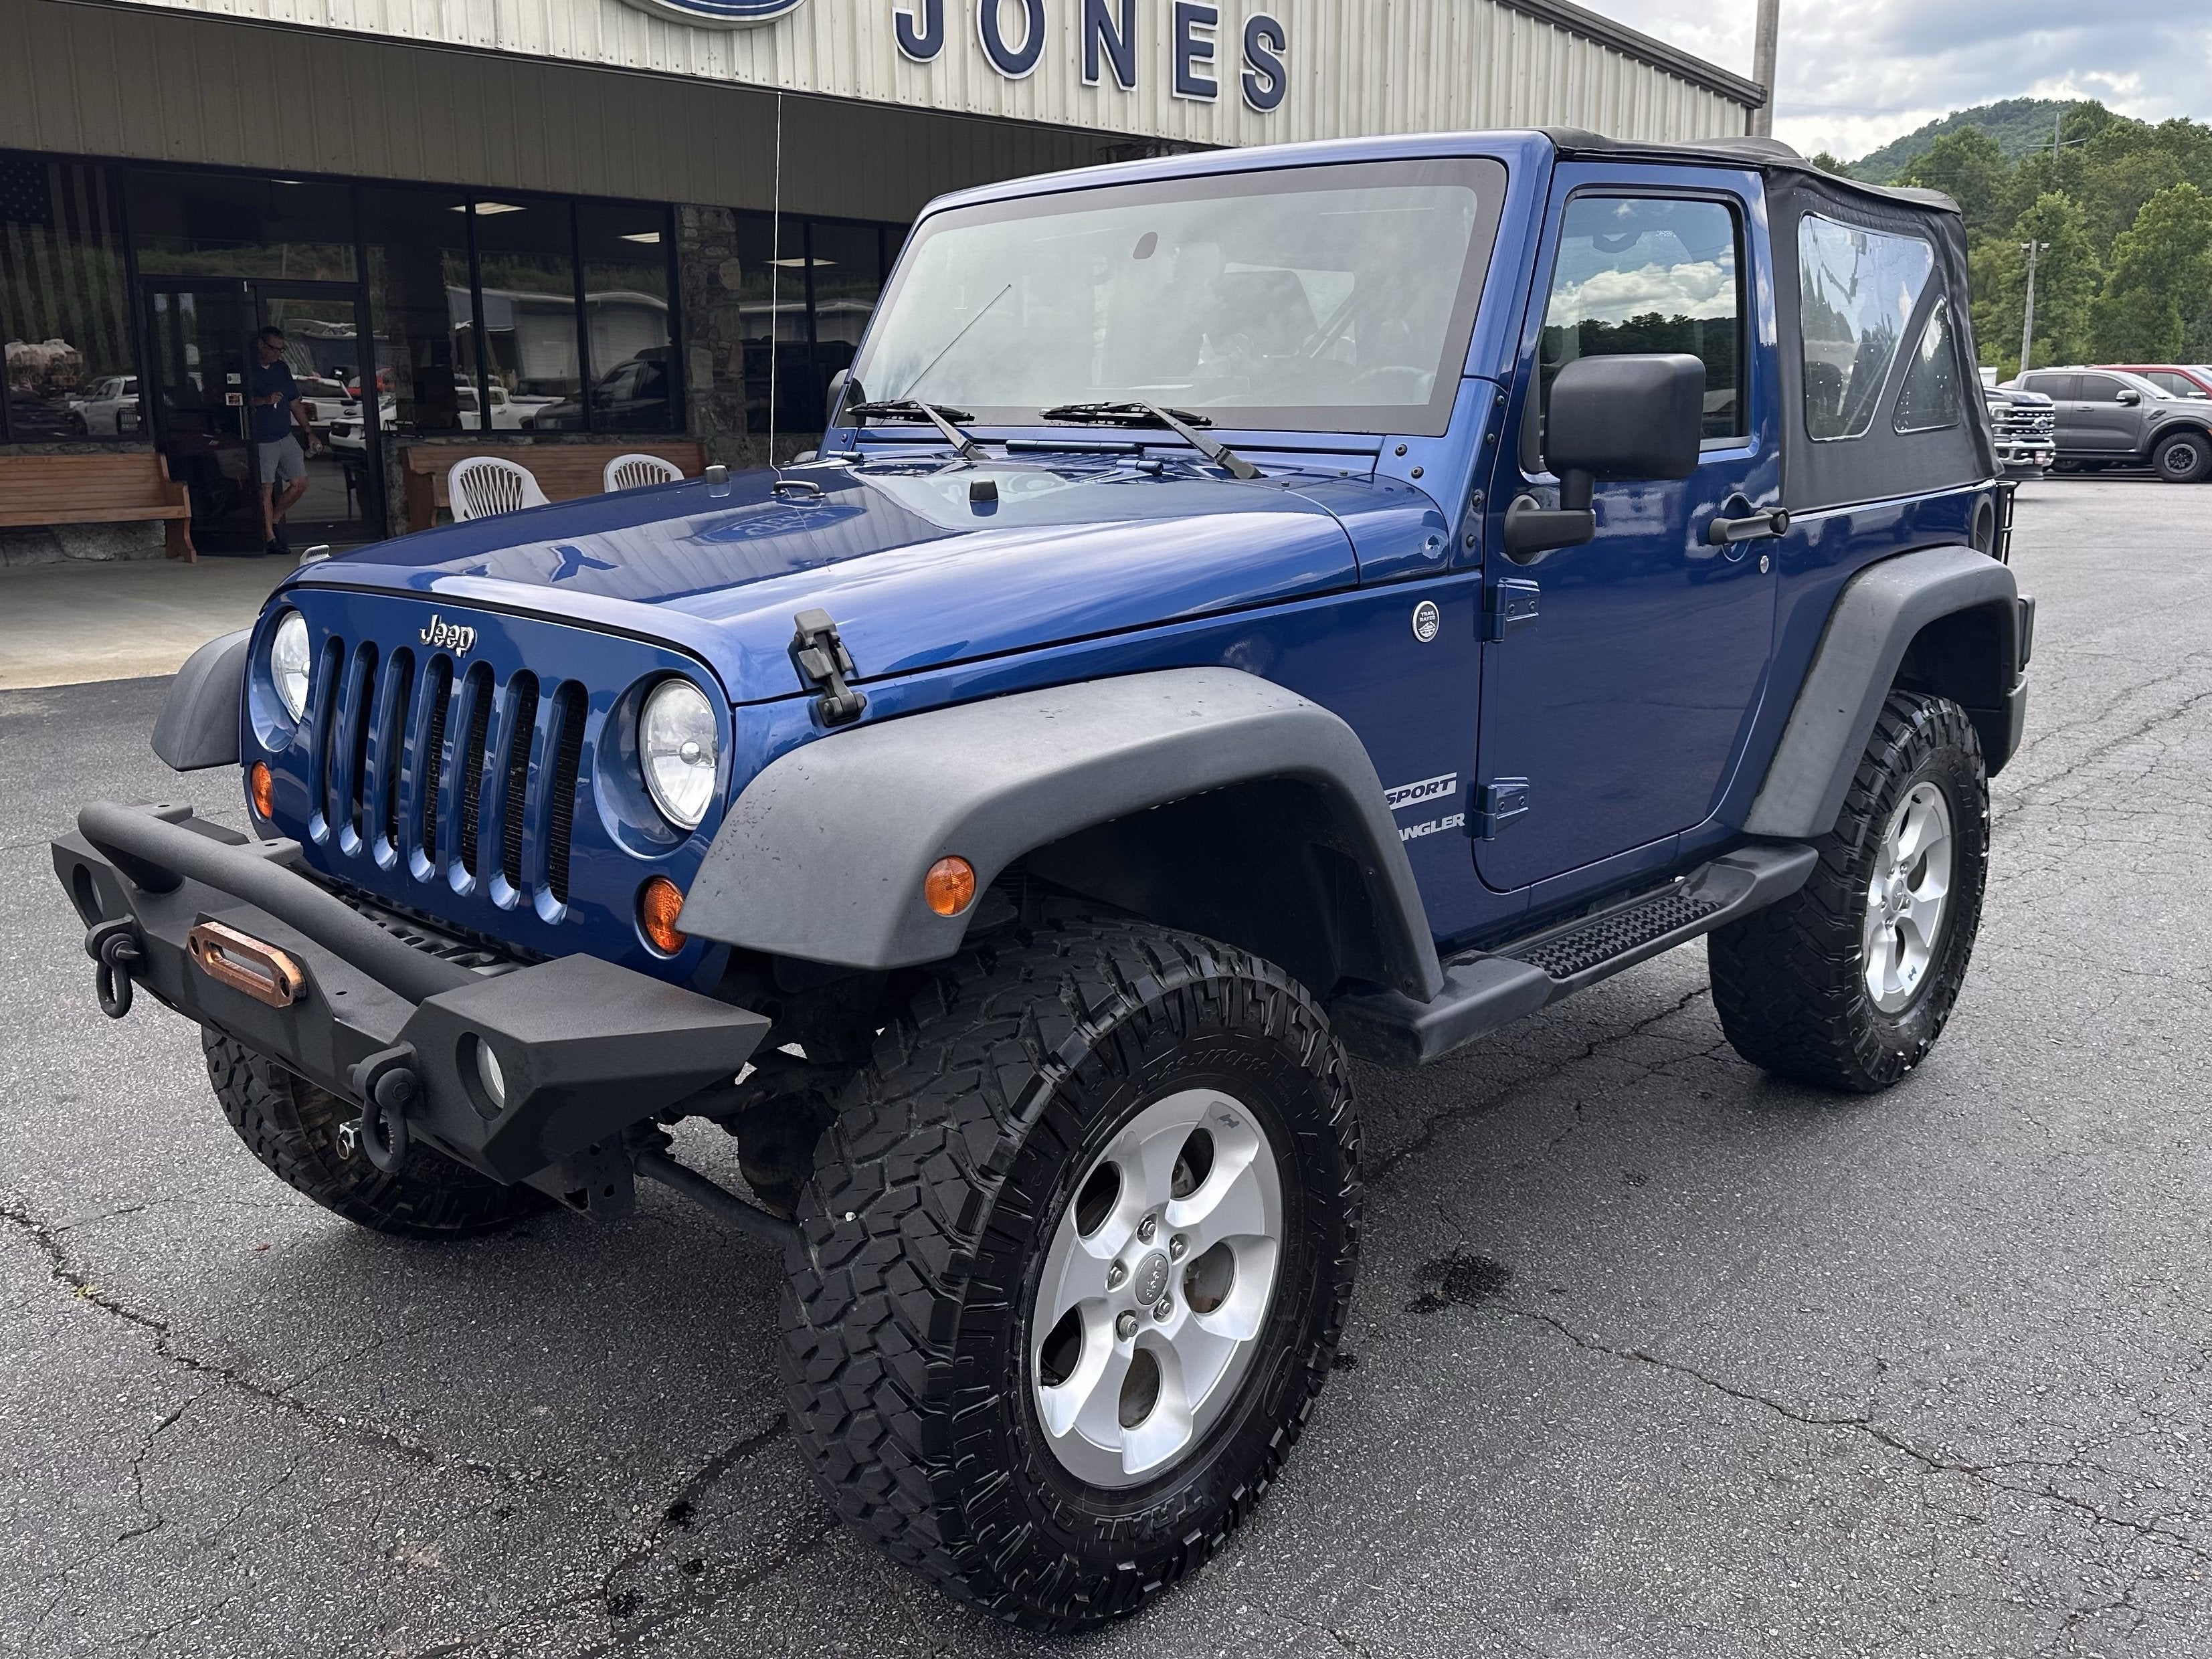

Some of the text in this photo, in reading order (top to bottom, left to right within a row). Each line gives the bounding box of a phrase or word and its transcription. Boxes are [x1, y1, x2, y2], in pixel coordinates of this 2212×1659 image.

[892, 0, 1287, 112] JONES
[419, 614, 476, 658] Jeep
[1386, 778, 1455, 805] SPORT
[1095, 1486, 1203, 1541] TRAIL
